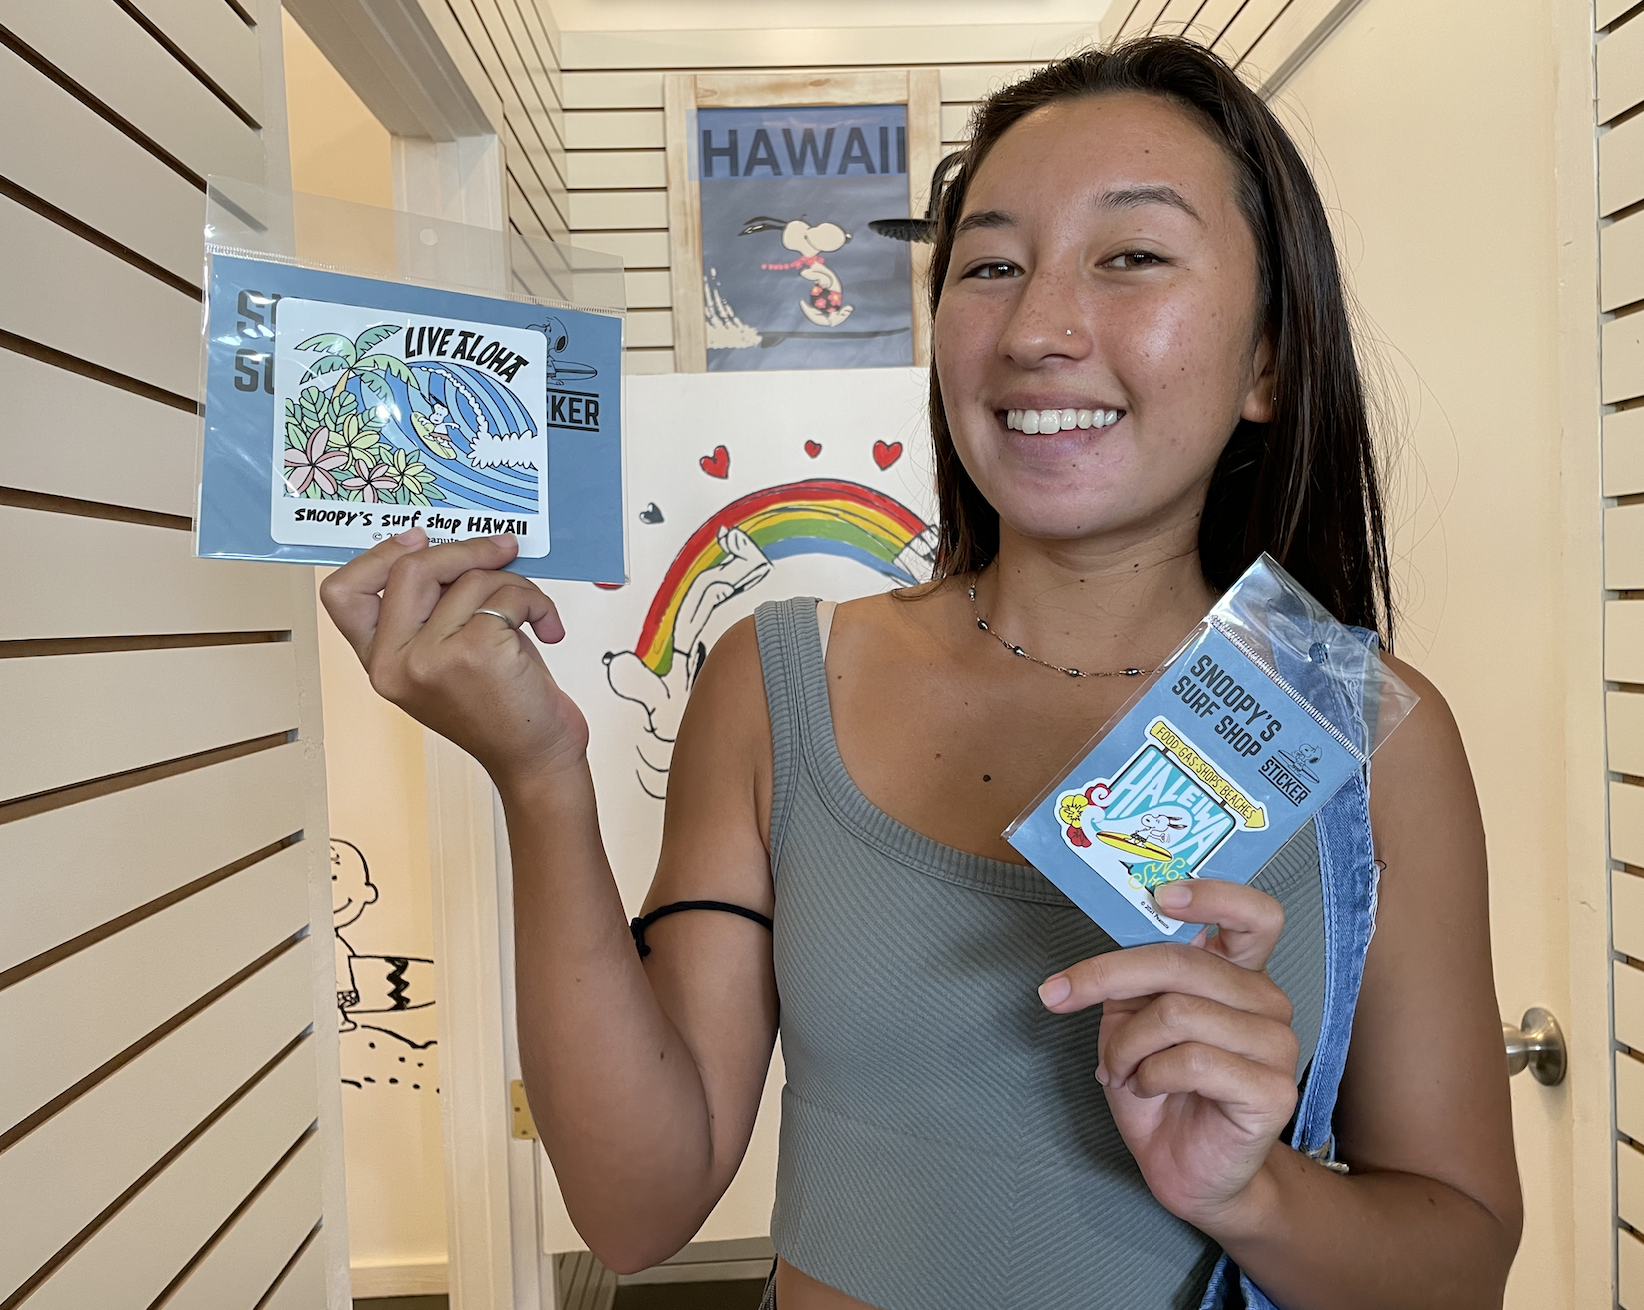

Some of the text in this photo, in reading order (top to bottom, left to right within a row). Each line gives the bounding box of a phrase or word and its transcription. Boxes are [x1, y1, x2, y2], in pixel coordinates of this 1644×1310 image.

[702, 126, 906, 177] HAWAII
[405, 326, 529, 383] LIVE ALOHA
[381, 511, 421, 528] surf
[426, 514, 462, 534] shop
[467, 516, 528, 535] HAWAII
[1171, 675, 1262, 757] SURF SHOP
[1190, 654, 1282, 742] SNOOPY'S
[1261, 758, 1309, 805] STICKER
